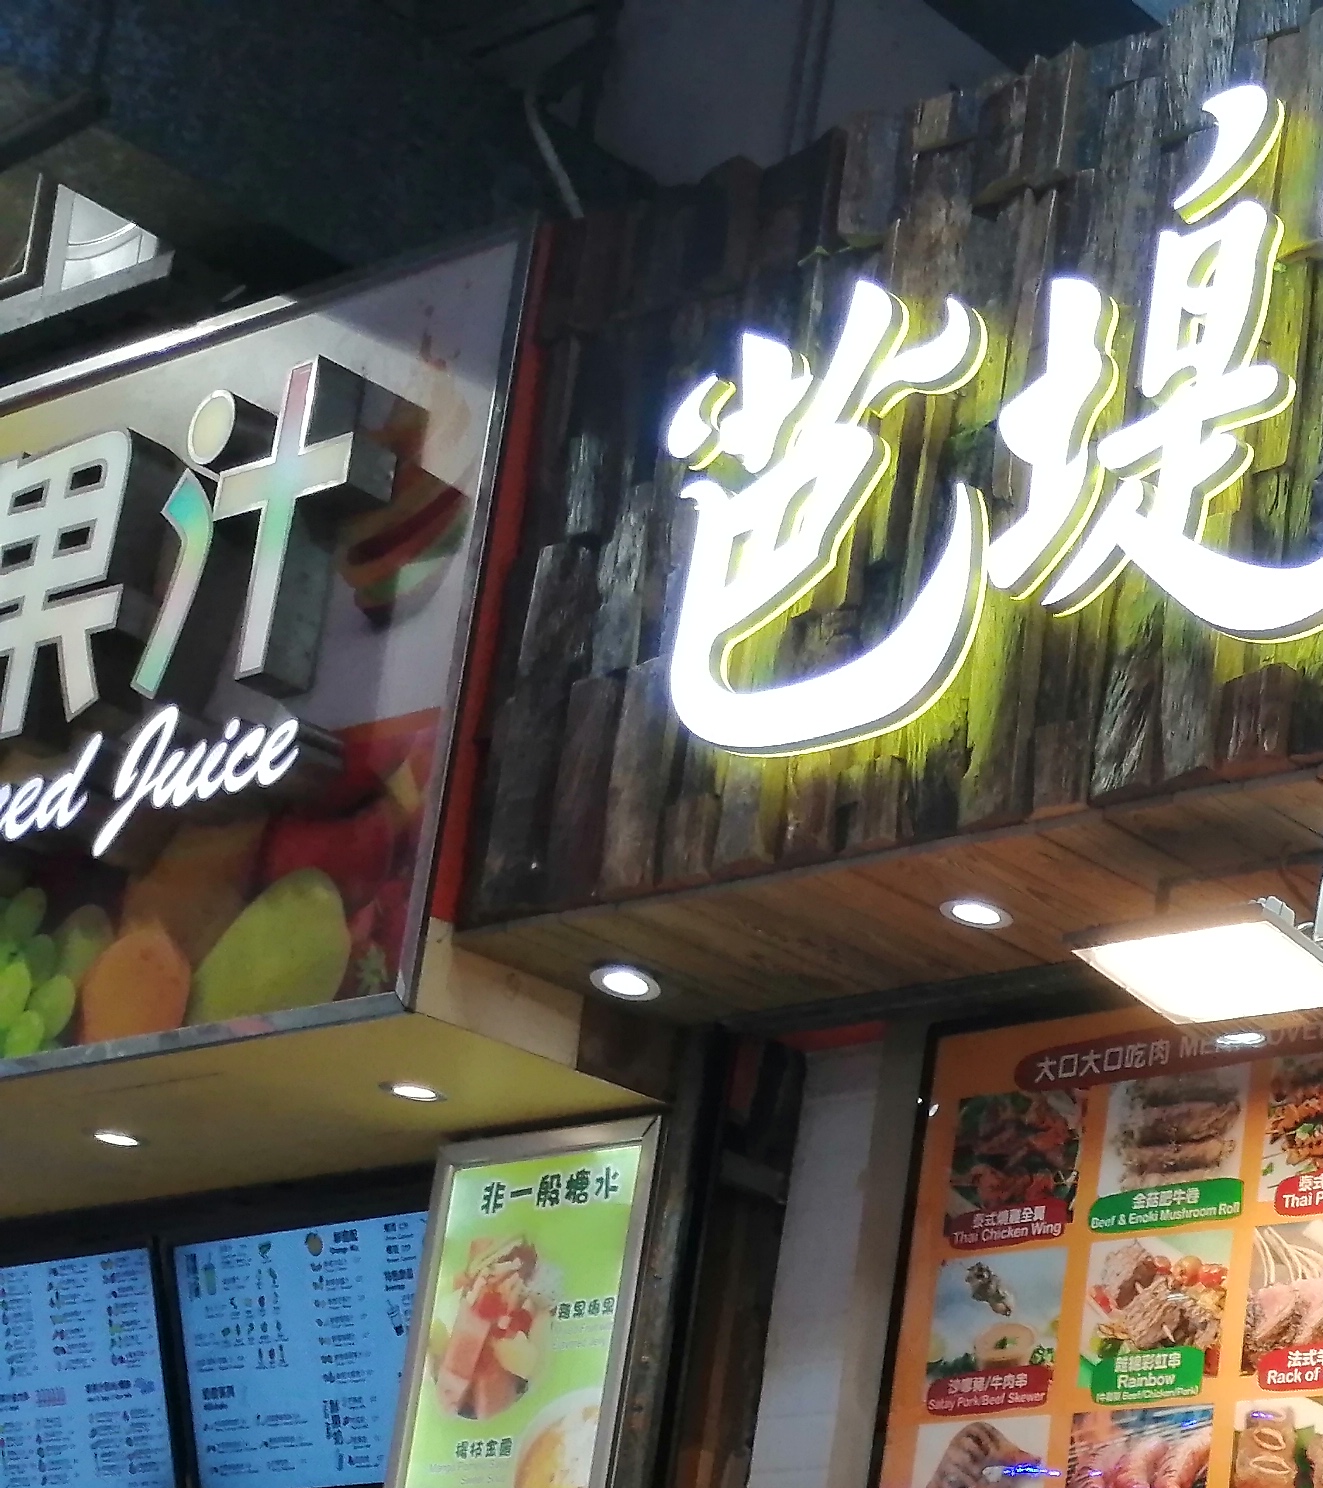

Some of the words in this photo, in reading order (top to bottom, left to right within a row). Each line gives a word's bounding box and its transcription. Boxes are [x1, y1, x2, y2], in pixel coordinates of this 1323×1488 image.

[0, 353, 353, 738] 果汁
[0, 731, 103, 842] ed
[91, 703, 300, 858] Juice
[1034, 1039, 1170, 1083] 大口大口吃肉
[1283, 1191, 1312, 1209] Thai
[1160, 1205, 1217, 1222] Mushroom
[1218, 1202, 1241, 1216] Roll
[953, 1229, 978, 1245] Thai
[981, 1225, 1029, 1242] Chicken
[1031, 1221, 1062, 1237] Wing
[1117, 1373, 1176, 1389] Rainbow
[1267, 1368, 1302, 1385] Rack
[1304, 1366, 1321, 1382] of
[1008, 1391, 1046, 1404] Skewer
